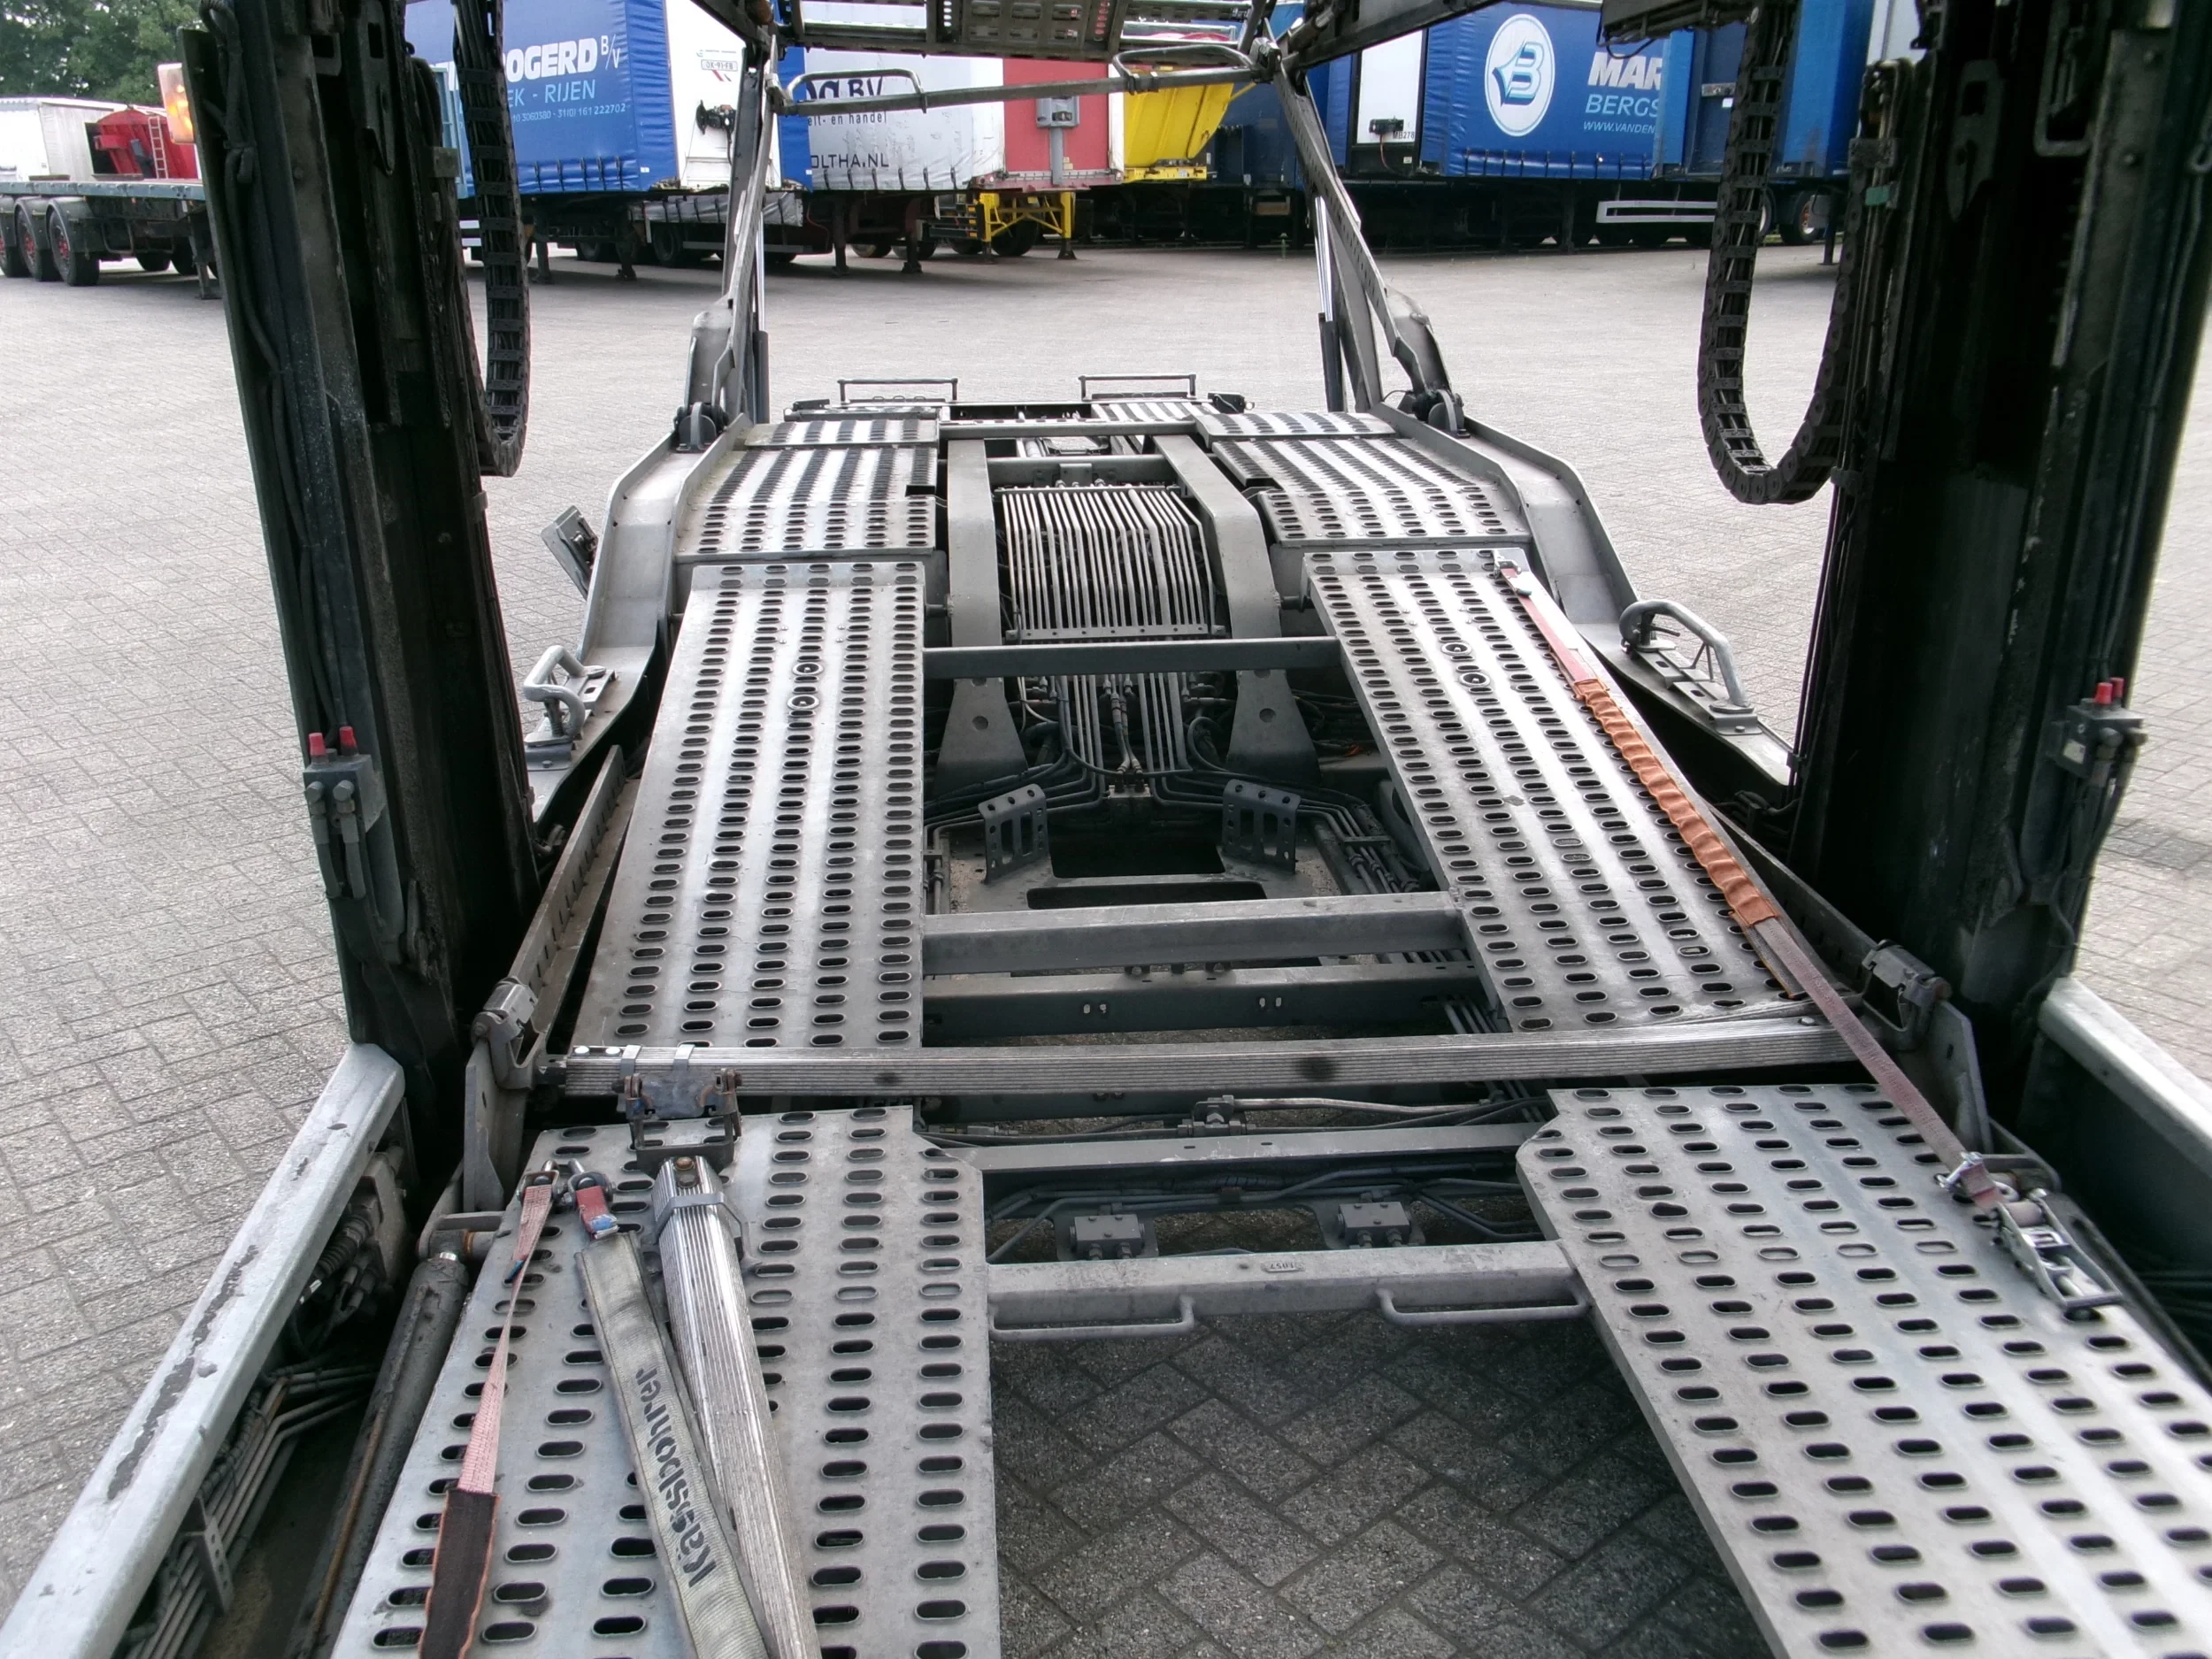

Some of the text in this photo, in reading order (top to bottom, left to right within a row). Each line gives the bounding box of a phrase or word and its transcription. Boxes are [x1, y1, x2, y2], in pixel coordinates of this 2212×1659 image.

[503, 38, 598, 82] OGERD
[544, 79, 595, 104] RIJEN
[594, 103, 626, 115] 222702
[831, 114, 843, 126] en
[849, 111, 887, 125] handel
